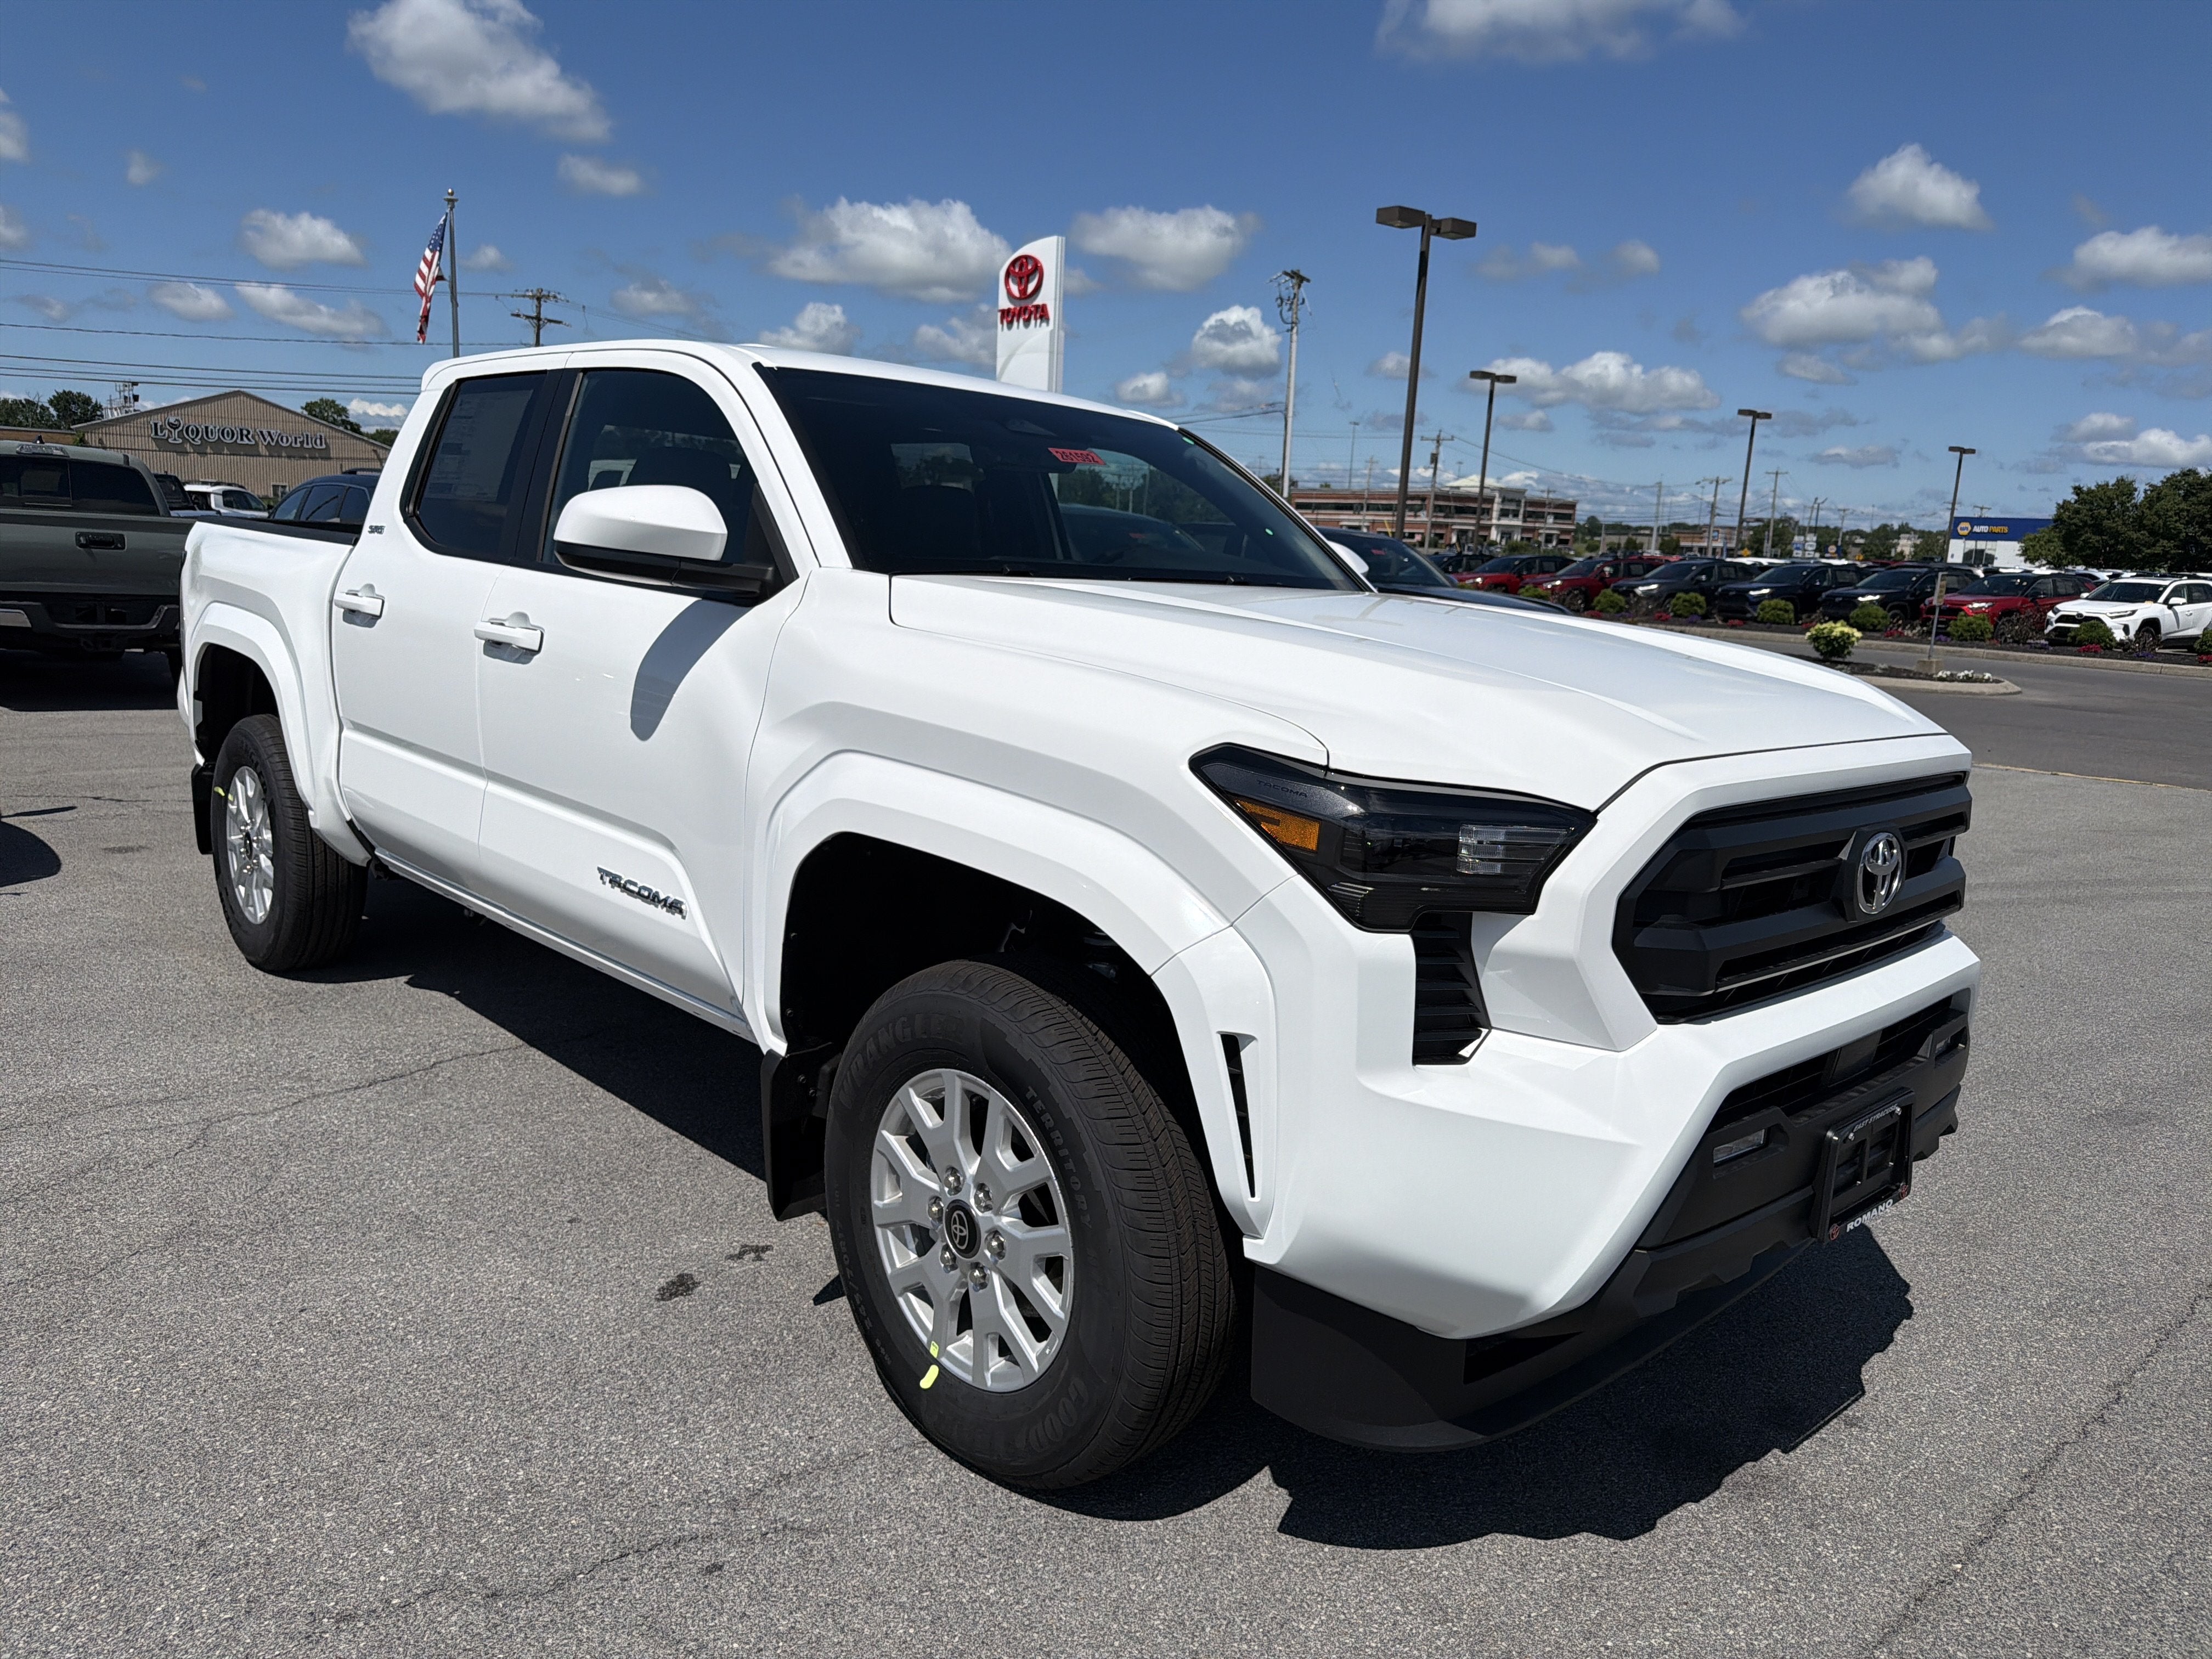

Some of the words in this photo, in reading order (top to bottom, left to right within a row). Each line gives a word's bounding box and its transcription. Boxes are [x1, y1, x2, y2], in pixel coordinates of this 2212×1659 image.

[998, 303, 1050, 325] TOYOTA
[256, 428, 326, 449] World
[1972, 525, 1989, 533] AUTO
[1989, 525, 2009, 533] PARTS
[1256, 778, 1308, 798] TACOMA
[597, 866, 688, 920] TACOMA
[1853, 1119, 1870, 1132] EAST
[1025, 1085, 1093, 1229] TERRITORY
[1846, 1199, 1893, 1233] ROMANO
